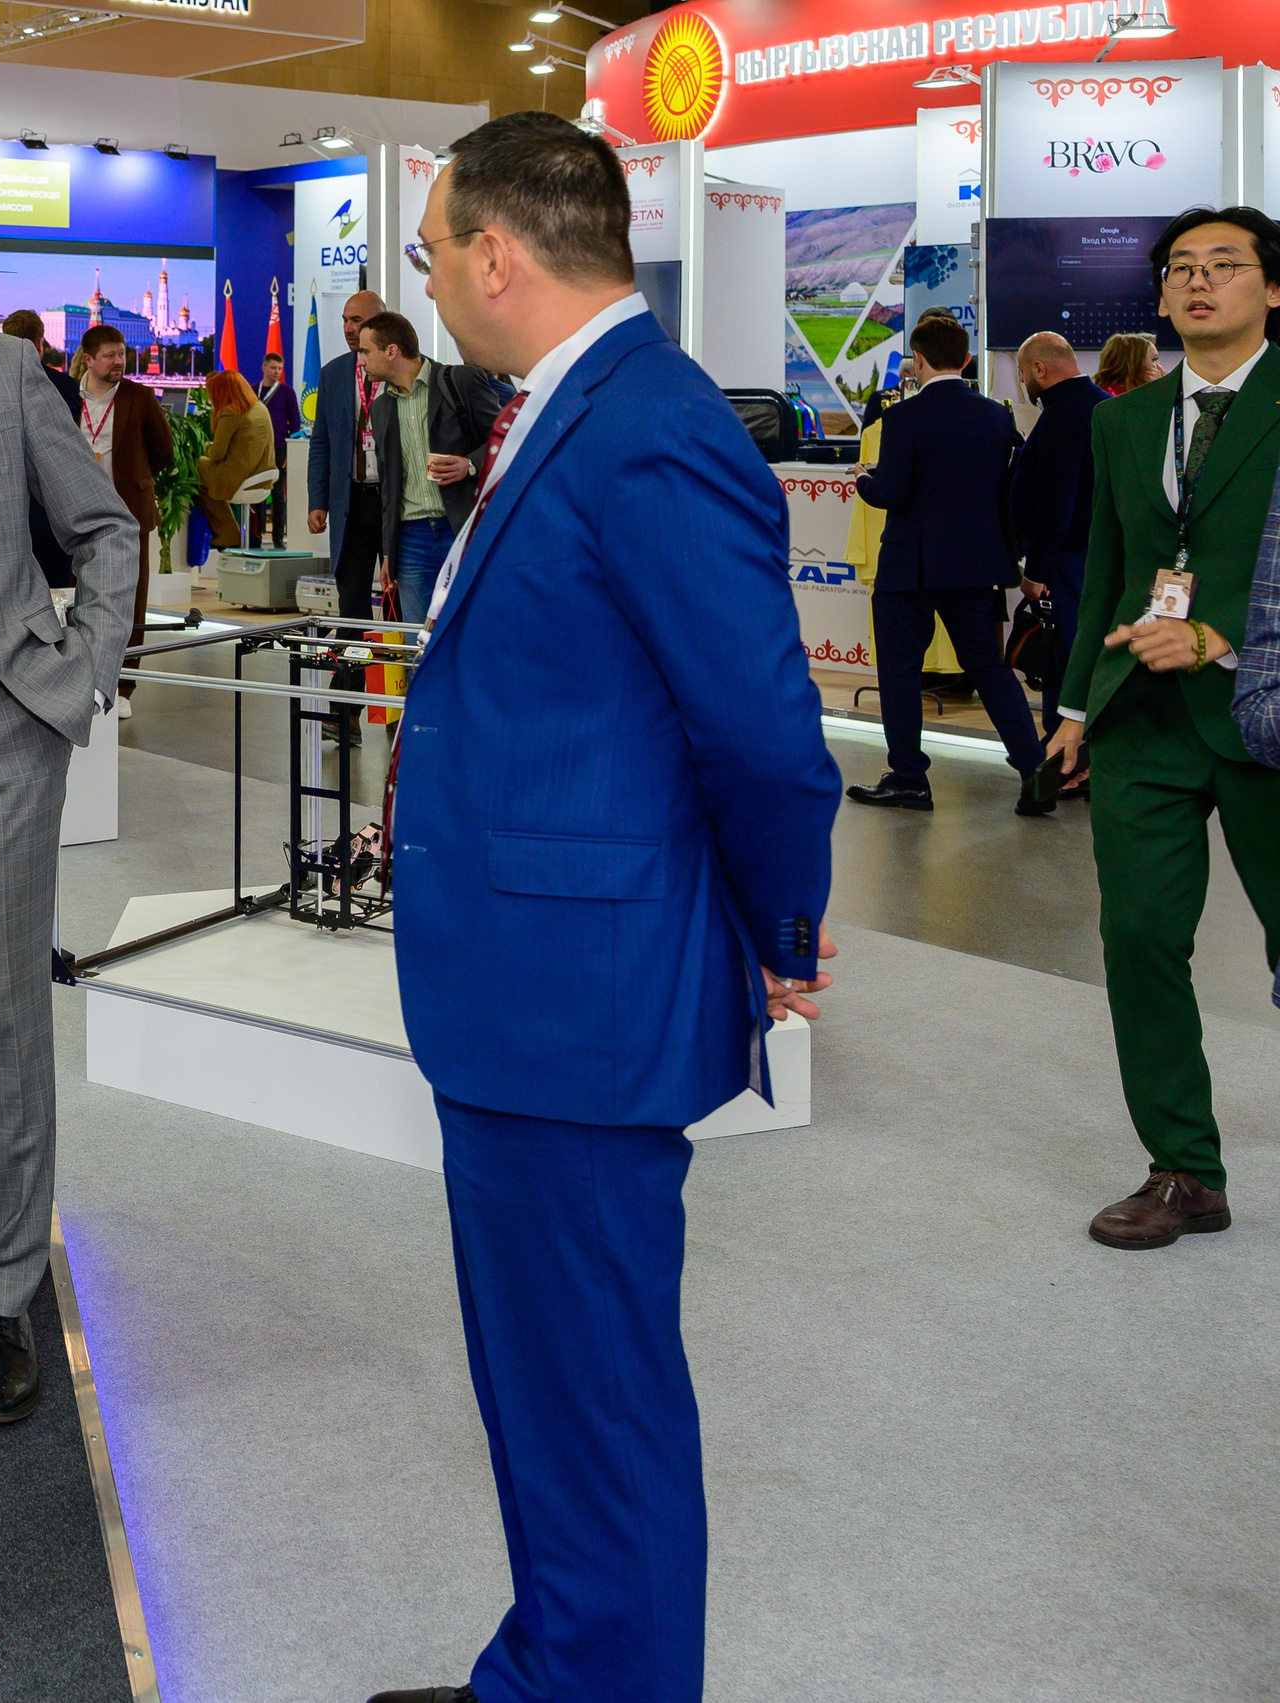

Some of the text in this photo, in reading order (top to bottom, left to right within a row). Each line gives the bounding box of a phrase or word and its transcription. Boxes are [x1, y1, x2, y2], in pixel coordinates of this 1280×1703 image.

[735, 23, 927, 84] КЫРГЫЗСКАЯ
[1047, 139, 1161, 173] BRAVO
[1081, 237, 1100, 245] Вход
